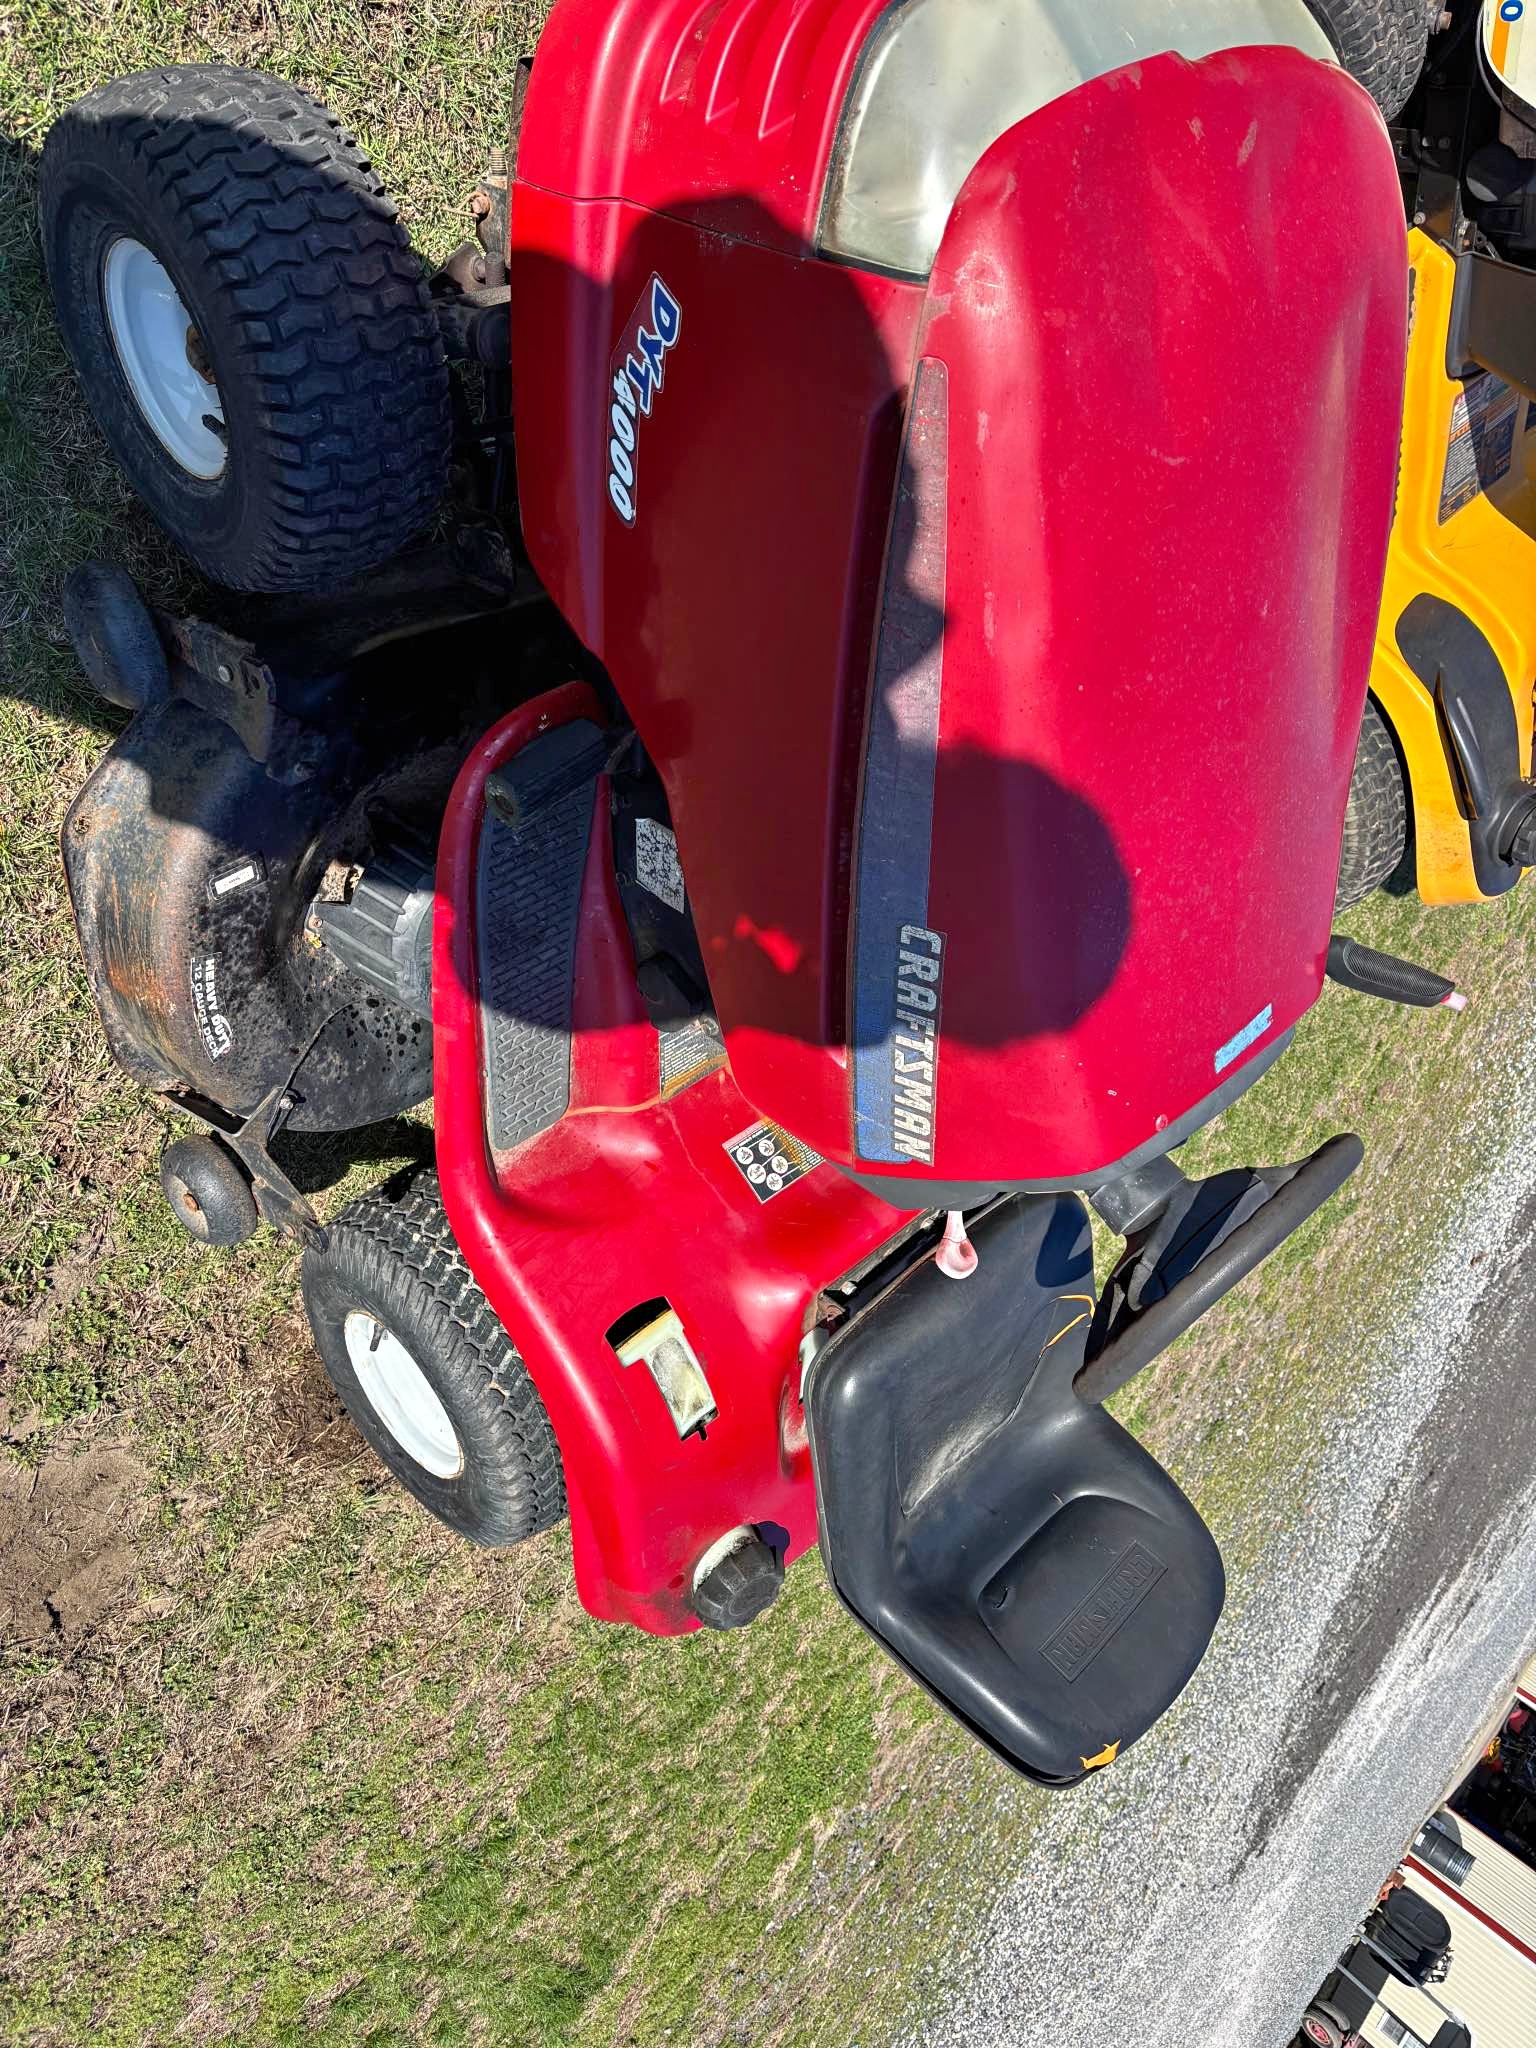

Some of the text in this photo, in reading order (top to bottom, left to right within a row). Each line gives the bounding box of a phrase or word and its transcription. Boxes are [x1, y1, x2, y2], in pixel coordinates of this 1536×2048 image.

[194, 963, 219, 1058] 12 GAUGE DECK
[205, 958, 229, 1053] HEAVY DUTY
[894, 924, 943, 1163] CRAFTSMAN
